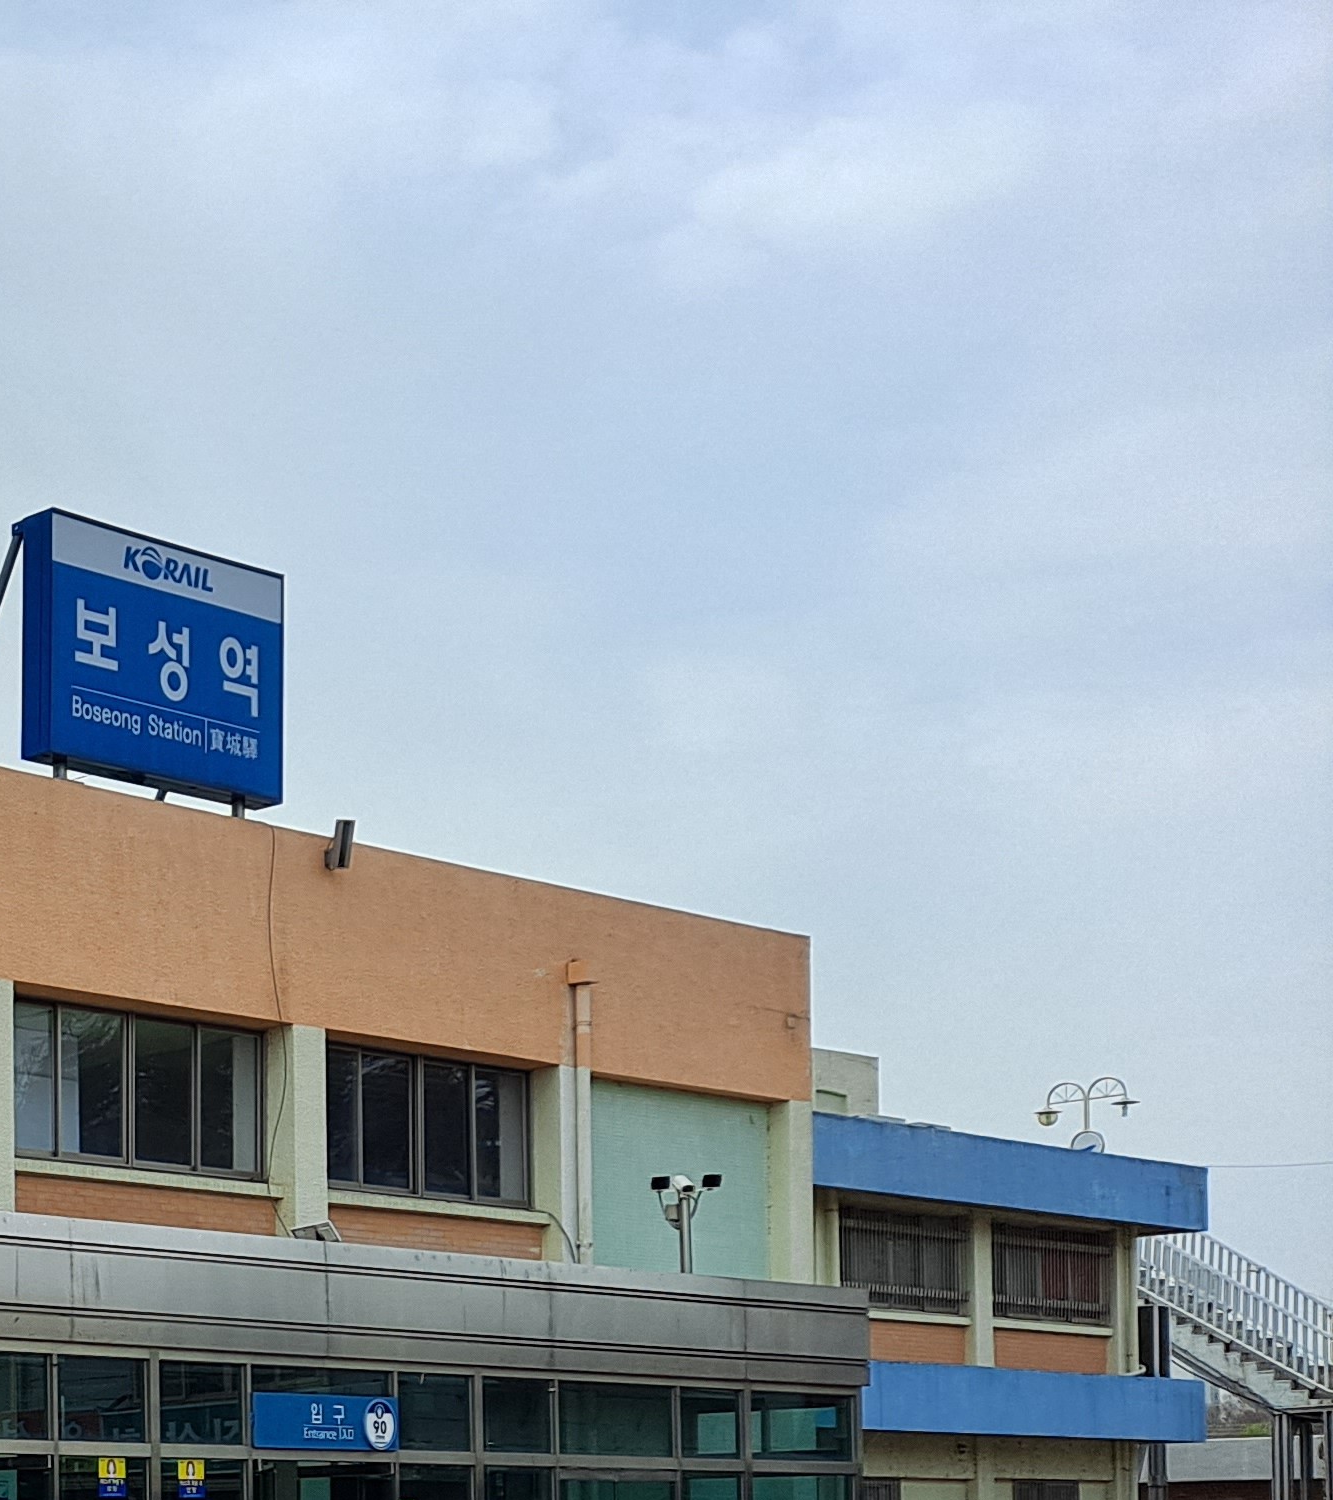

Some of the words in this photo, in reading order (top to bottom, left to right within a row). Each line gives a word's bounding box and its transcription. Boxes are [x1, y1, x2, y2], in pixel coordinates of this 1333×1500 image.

[123, 545, 215, 592] KORAIL
[72, 695, 141, 734] Boseong
[148, 714, 202, 747] Station
[373, 1420, 387, 1435] 90
